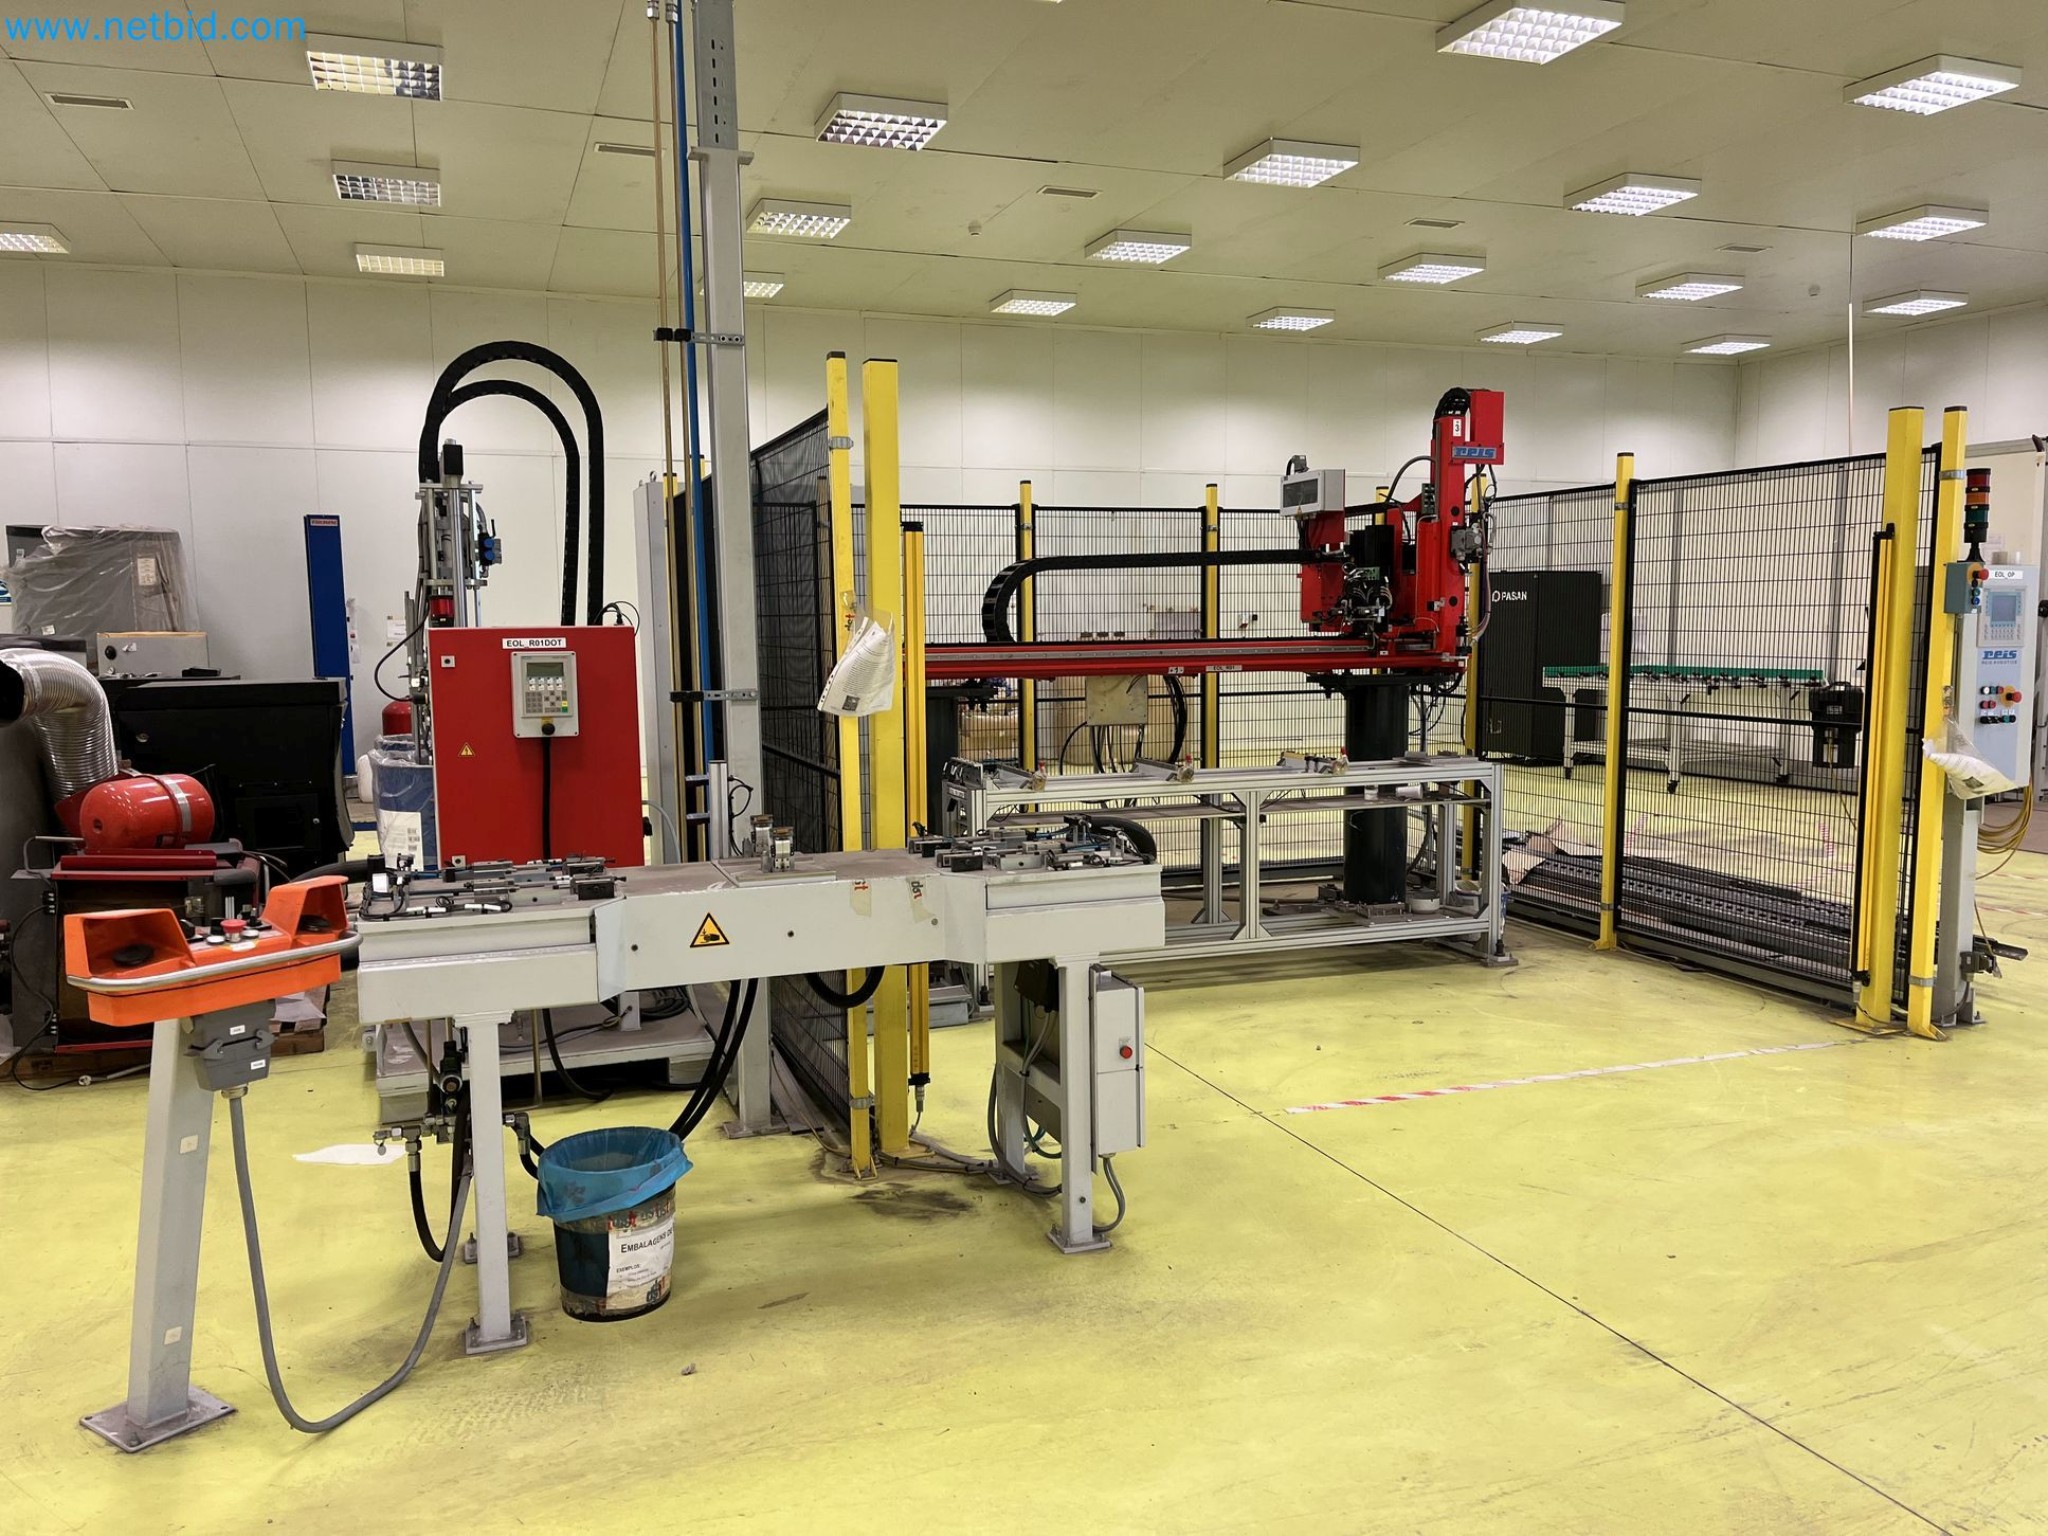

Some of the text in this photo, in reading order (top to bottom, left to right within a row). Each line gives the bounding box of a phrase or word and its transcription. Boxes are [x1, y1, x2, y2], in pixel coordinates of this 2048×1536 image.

[1501, 591, 1528, 601] PASAN
[506, 639, 562, 649] EOL_R01DOT
[1983, 650, 2017, 660] reis
[621, 1233, 667, 1253] EMBALAGENS
